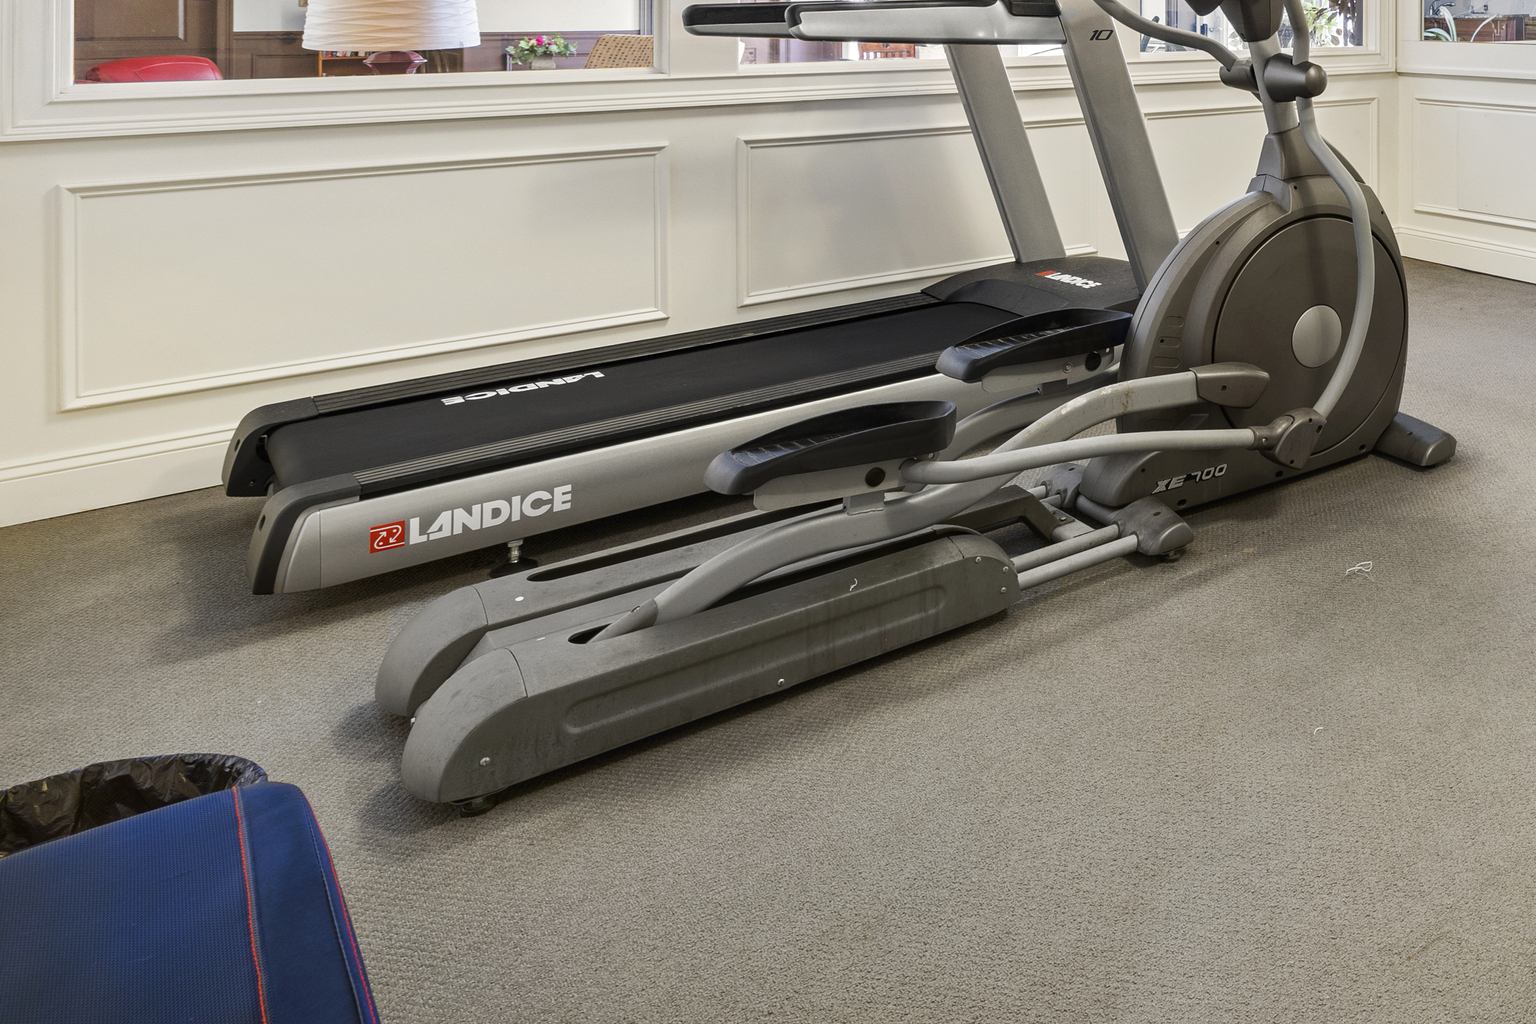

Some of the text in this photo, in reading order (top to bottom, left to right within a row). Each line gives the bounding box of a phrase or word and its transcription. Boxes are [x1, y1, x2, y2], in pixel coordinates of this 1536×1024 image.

[1090, 29, 1114, 41] 10
[441, 371, 605, 406] LANDICE
[1151, 463, 1228, 494] XE 700
[409, 484, 572, 545] LANDICE
